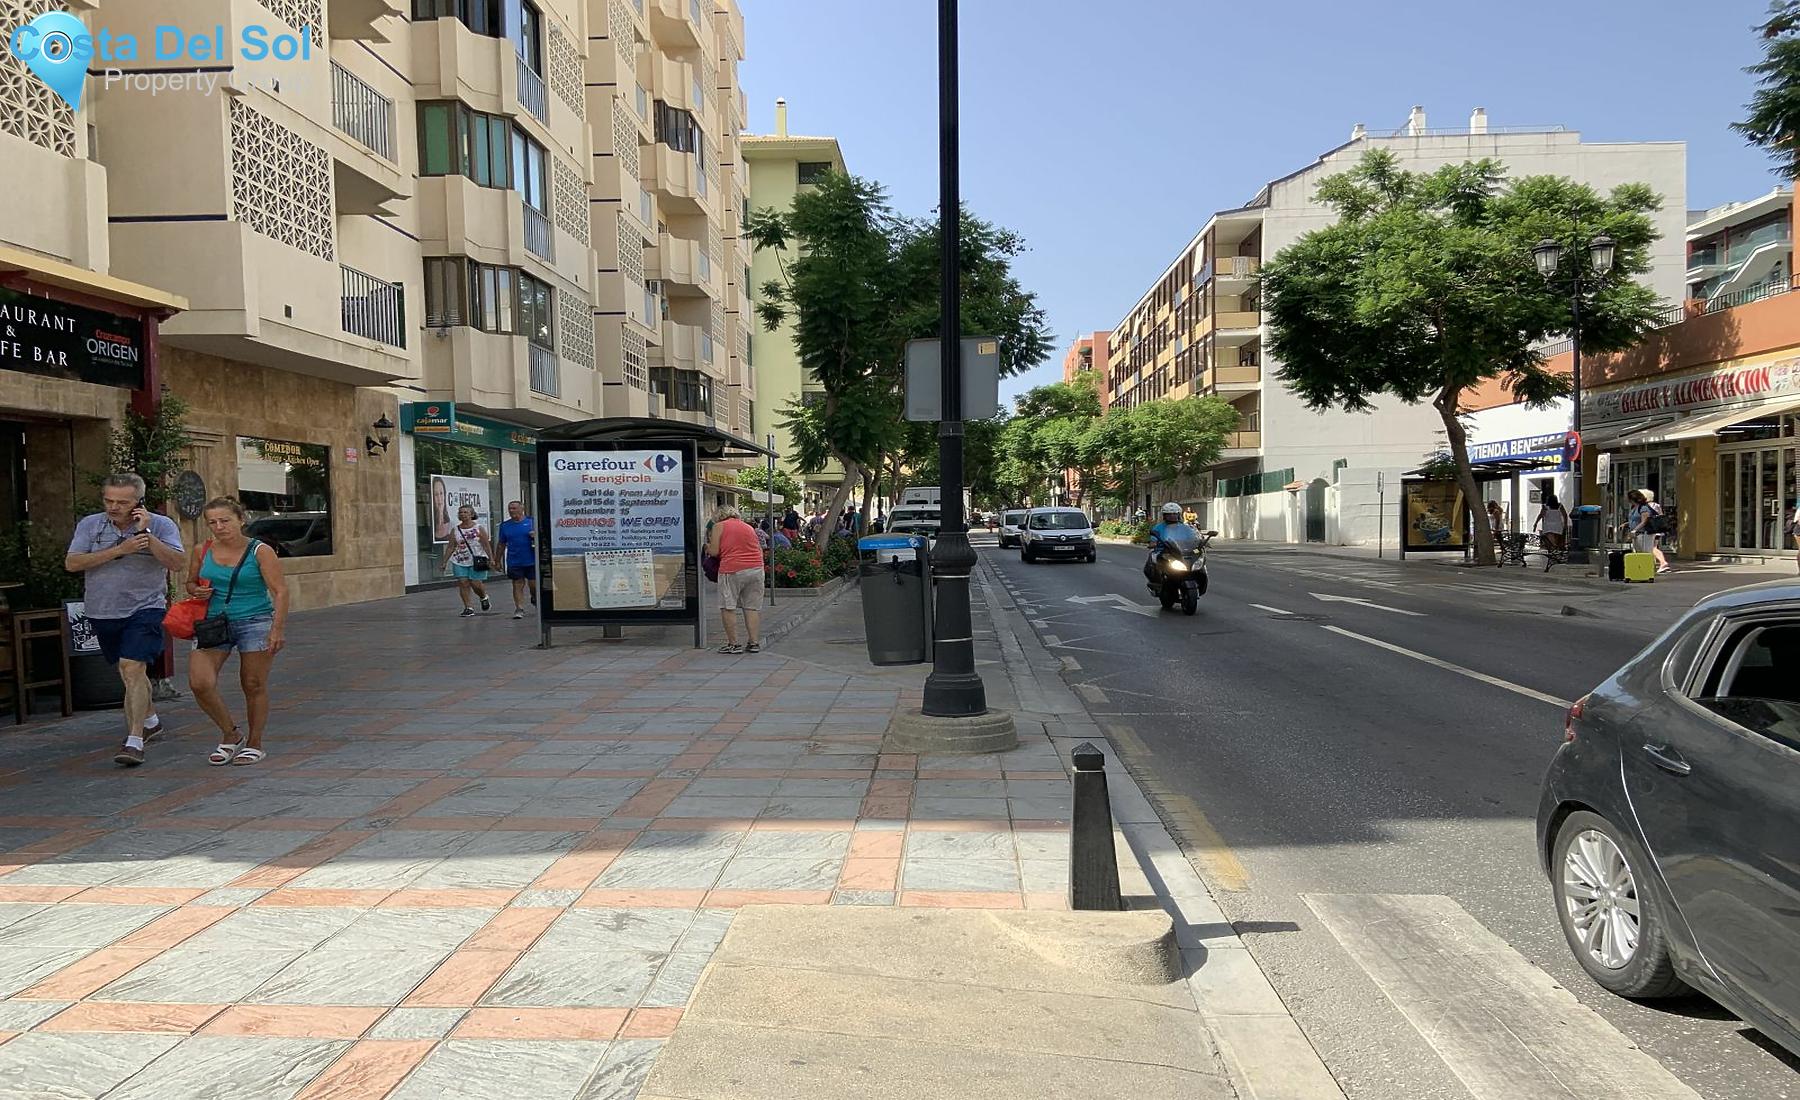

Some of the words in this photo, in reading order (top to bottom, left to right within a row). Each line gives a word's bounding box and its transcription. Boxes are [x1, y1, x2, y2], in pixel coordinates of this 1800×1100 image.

[6, 324, 16, 338] &
[86, 338, 138, 362] ORIGEN
[34, 346, 68, 367] BAR
[1621, 389, 1659, 414] BAZAR
[416, 417, 449, 425] cajamar
[264, 442, 301, 456] COMEDOR
[1474, 442, 1509, 460] TIENDA
[1510, 434, 1565, 456] BENEFIC
[554, 458, 637, 471] Carrefour
[581, 474, 652, 485] Fuengirola
[582, 489, 597, 497] Del
[603, 489, 615, 497] de
[644, 489, 662, 498] July
[603, 498, 615, 506] de
[619, 499, 668, 507] September
[564, 507, 616, 516] septiembre
[620, 517, 642, 527] WE
[643, 517, 681, 527] OPEN
